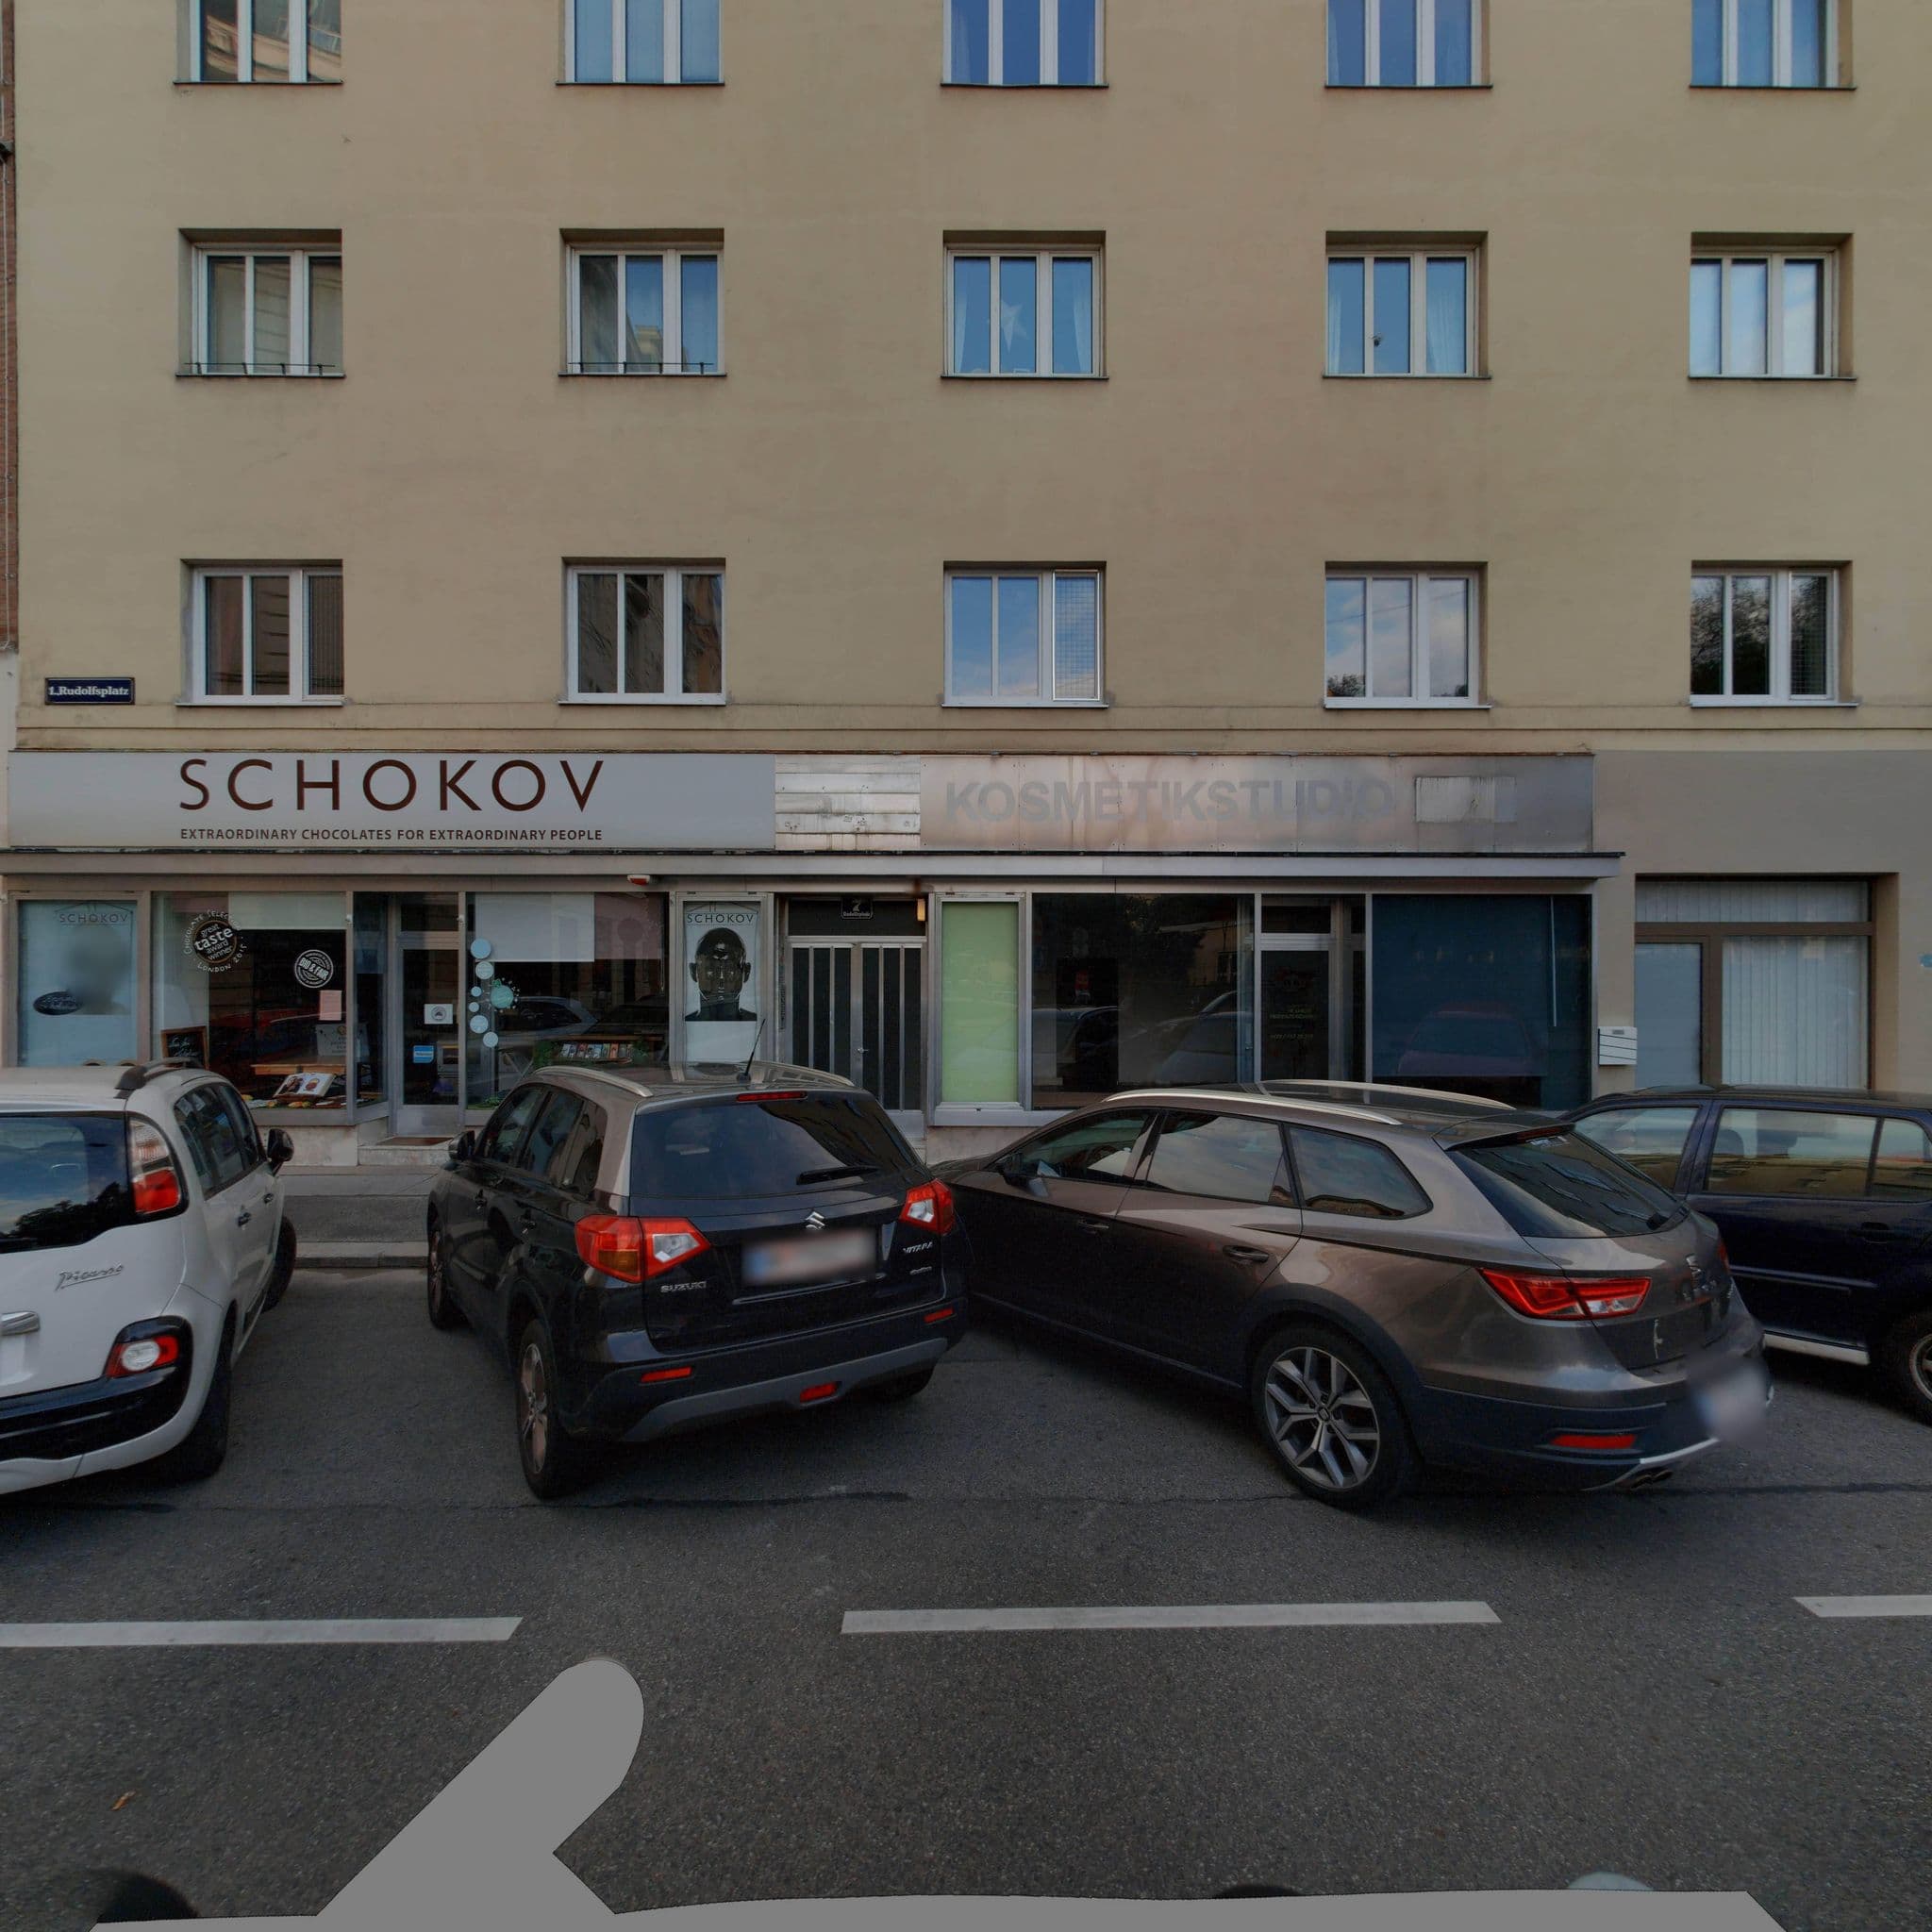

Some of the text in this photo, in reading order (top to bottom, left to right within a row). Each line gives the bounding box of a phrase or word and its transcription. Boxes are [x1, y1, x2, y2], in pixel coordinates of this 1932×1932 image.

[180, 758, 604, 813] SCHOKOV
[945, 780, 1394, 822] KOSMETIKSTUDIO
[180, 828, 603, 841] EXTRAORDINARY CHOCOLATES FOR EXTRAORDINARY PEOPLE
[59, 912, 128, 924] SCHOKOV
[687, 912, 755, 924] SCHOKOV
[201, 924, 220, 938] great
[194, 927, 234, 951] taste
[206, 939, 229, 955] award
[208, 945, 234, 960] winner
[197, 961, 231, 973] LONDON
[659, 1280, 707, 1293] SUZUKI
